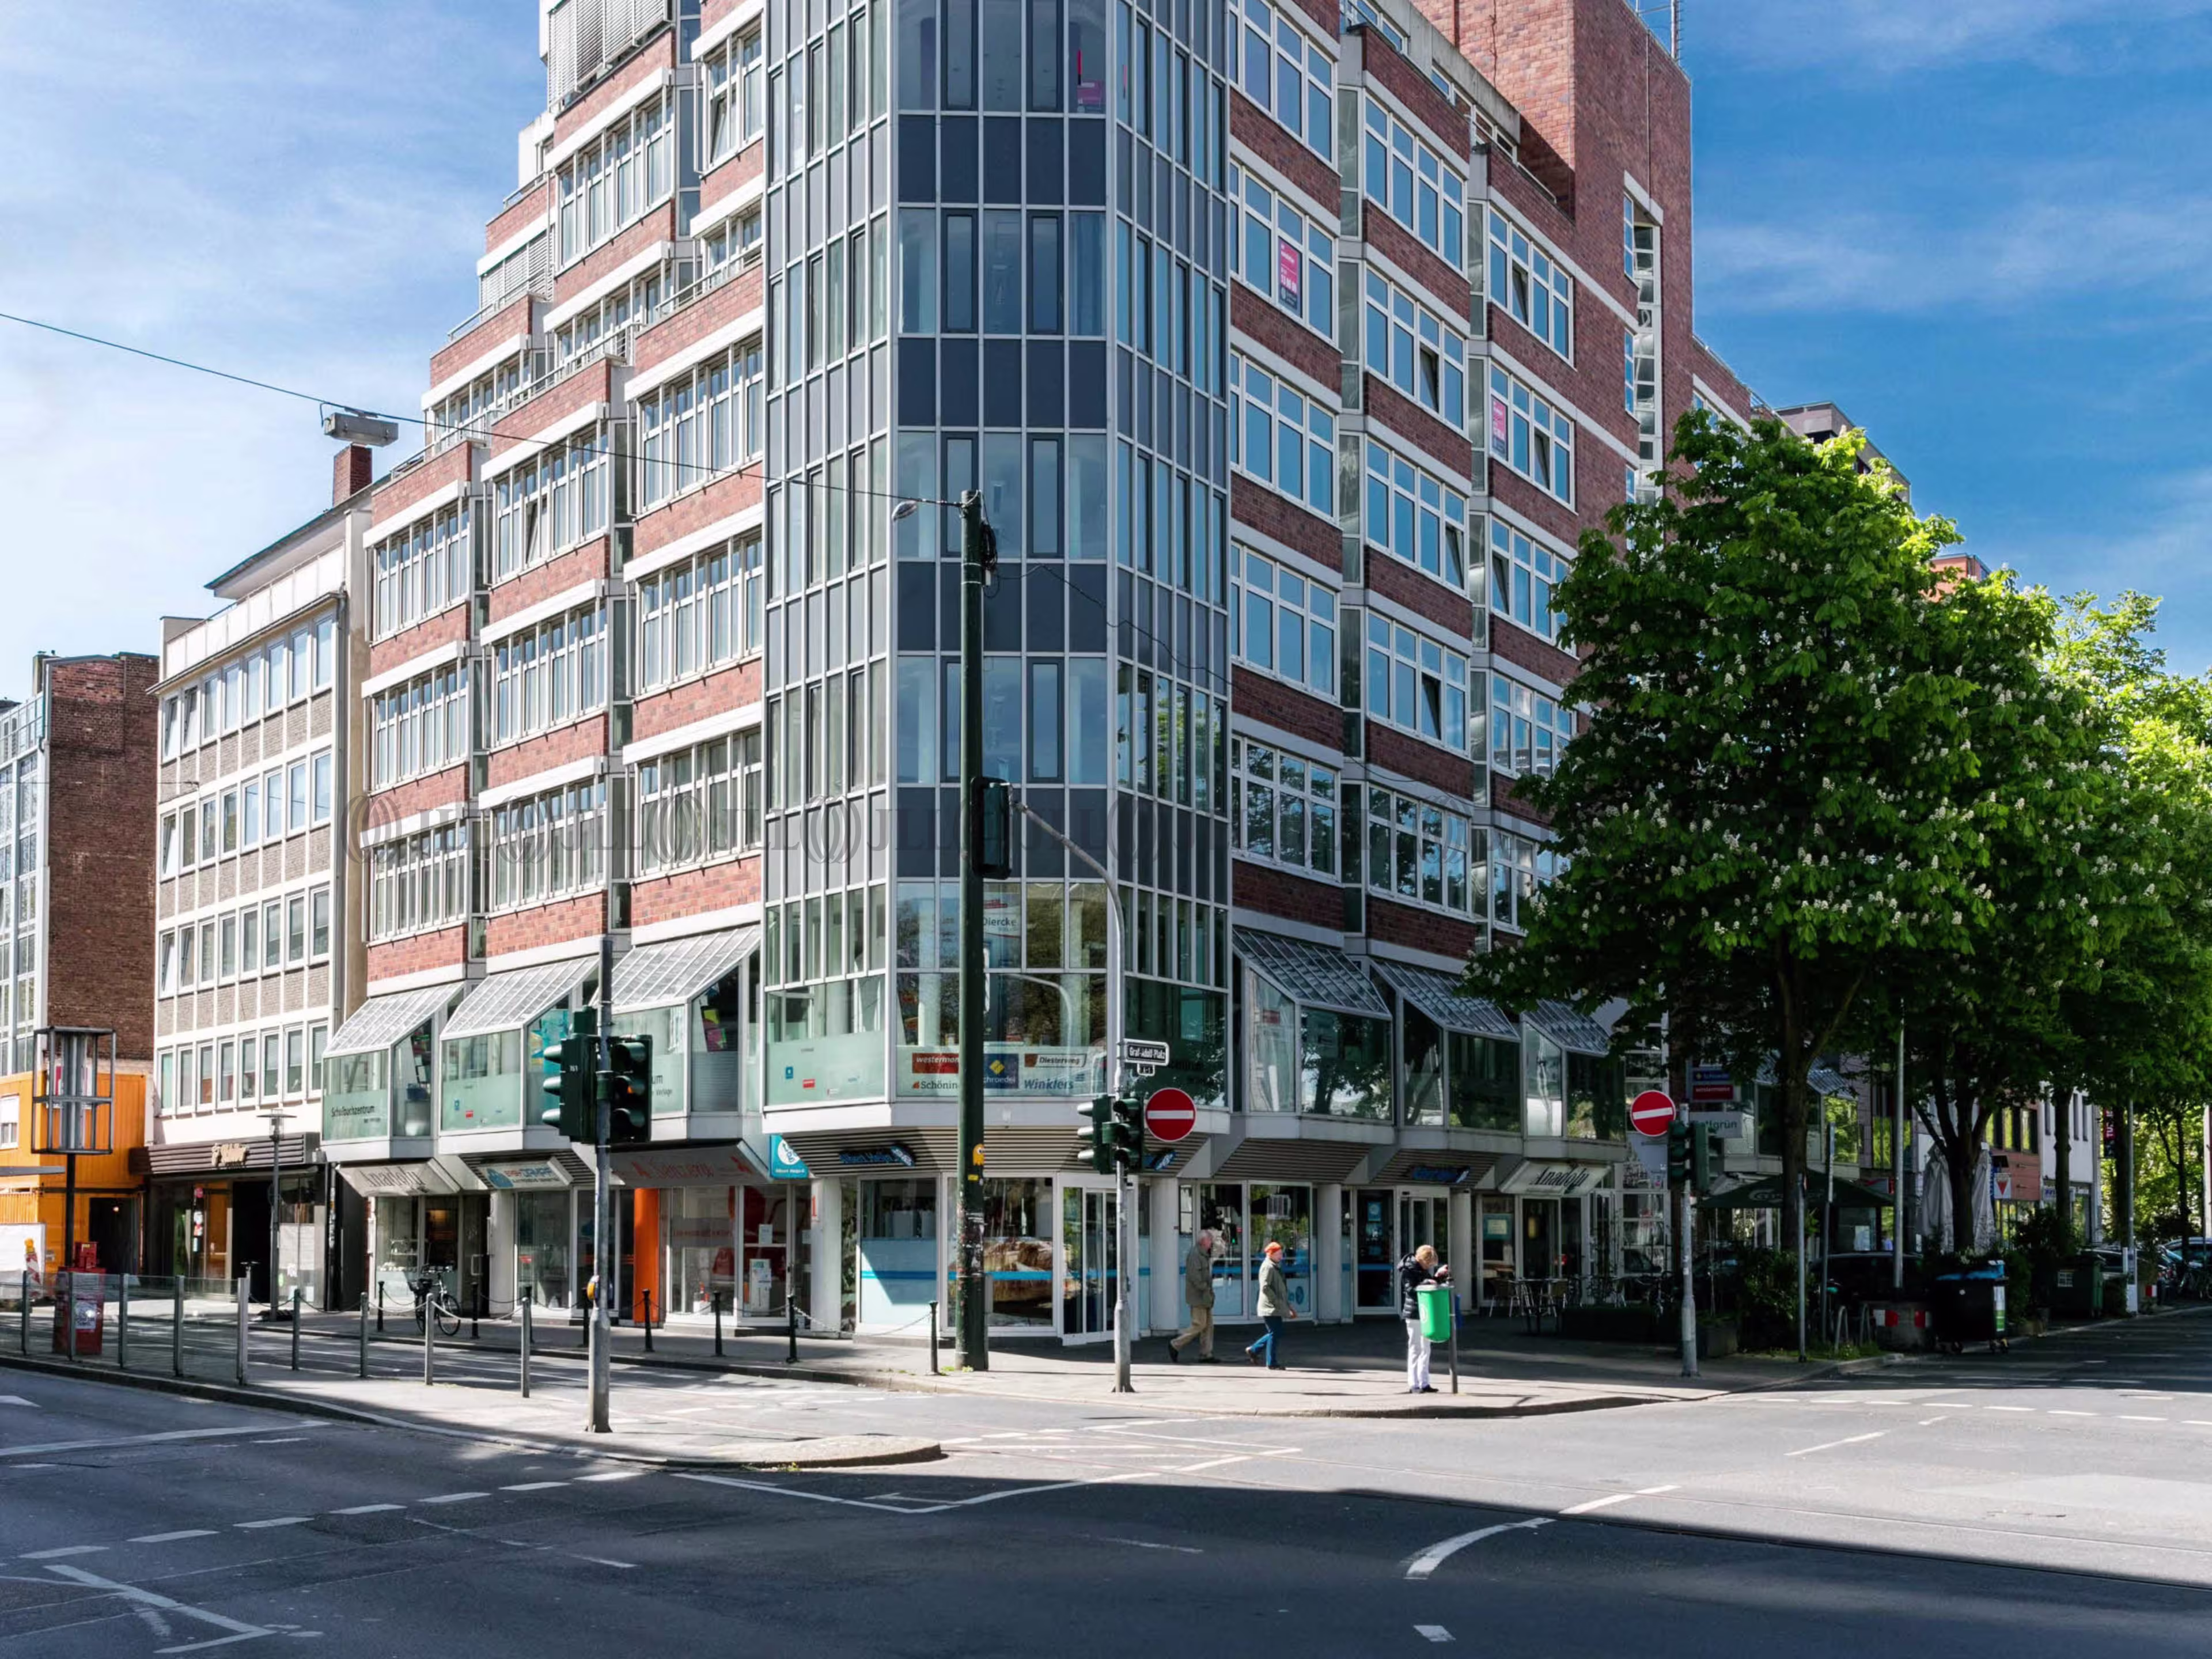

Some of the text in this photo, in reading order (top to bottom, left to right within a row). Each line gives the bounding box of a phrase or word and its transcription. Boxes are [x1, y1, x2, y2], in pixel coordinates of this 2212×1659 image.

[1039, 1056, 1080, 1065] Diesterweg
[921, 1080, 959, 1089] Schönin
[1024, 1078, 1074, 1089] Winklers
[1529, 1166, 1590, 1187] Anadolu
